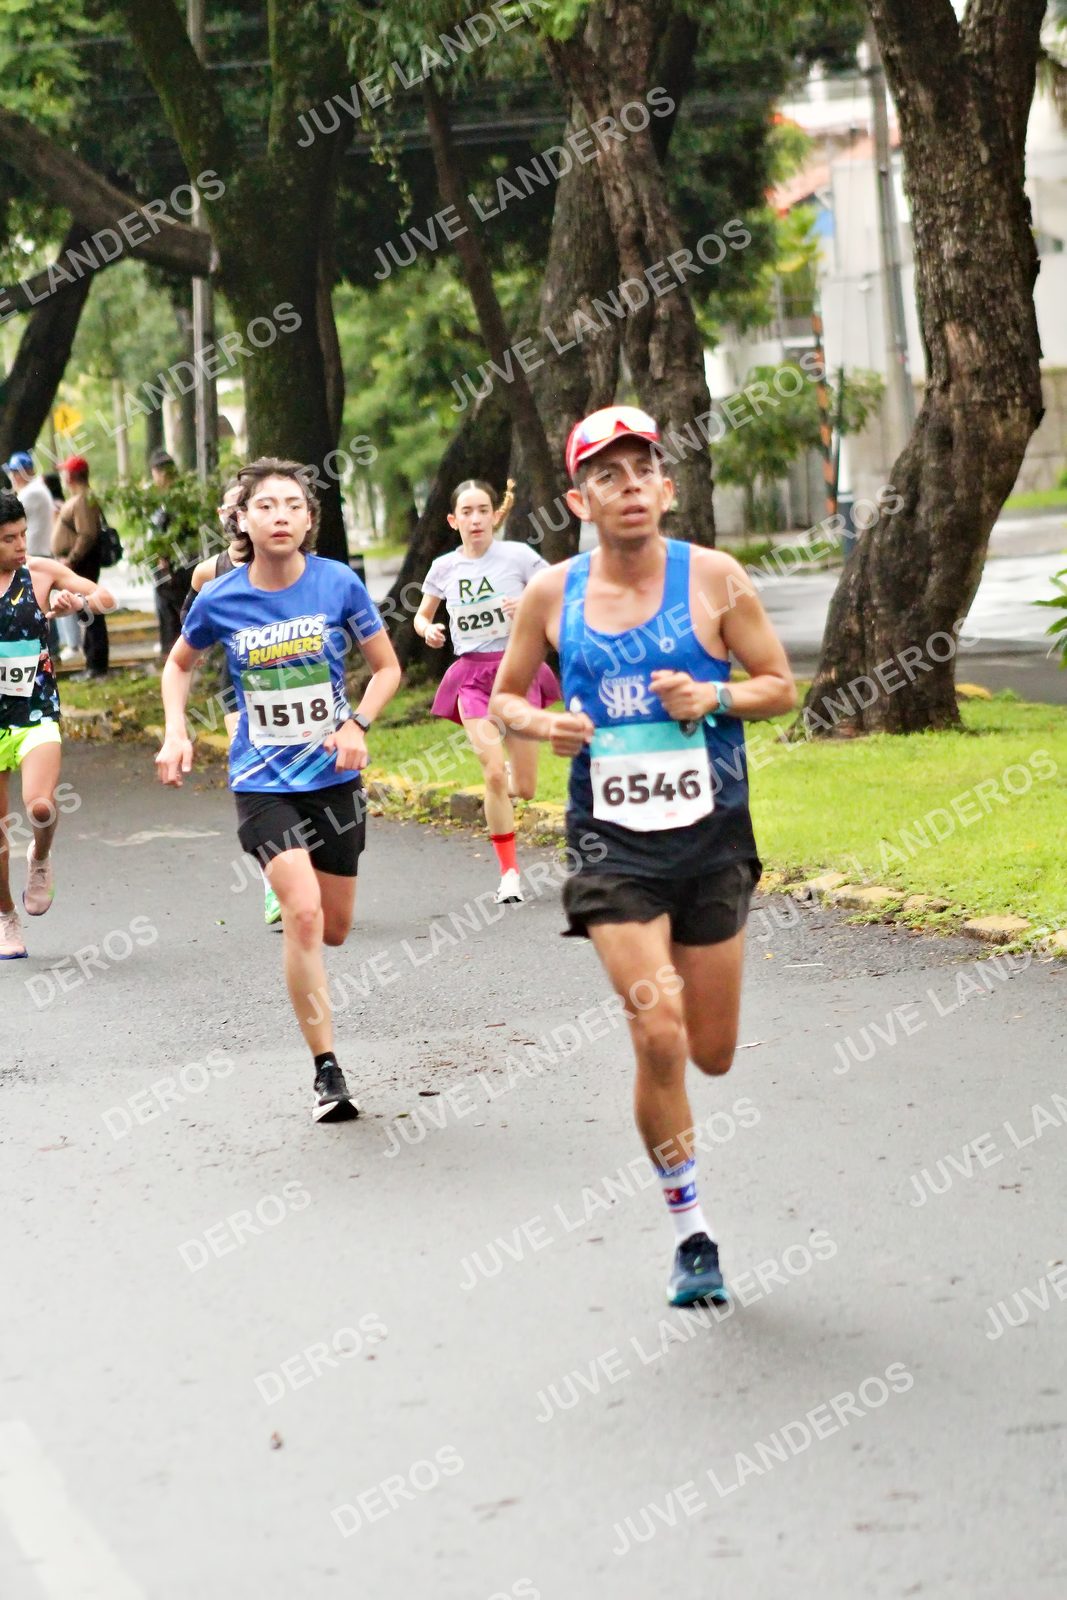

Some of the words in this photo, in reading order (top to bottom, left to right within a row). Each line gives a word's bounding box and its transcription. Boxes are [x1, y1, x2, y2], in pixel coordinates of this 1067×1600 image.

[457, 608, 505, 631] 6291
[236, 615, 325, 657] TOCHITOS
[248, 635, 322, 666] RUNNERS
[254, 698, 328, 727] 1518
[602, 769, 701, 806] 6546
